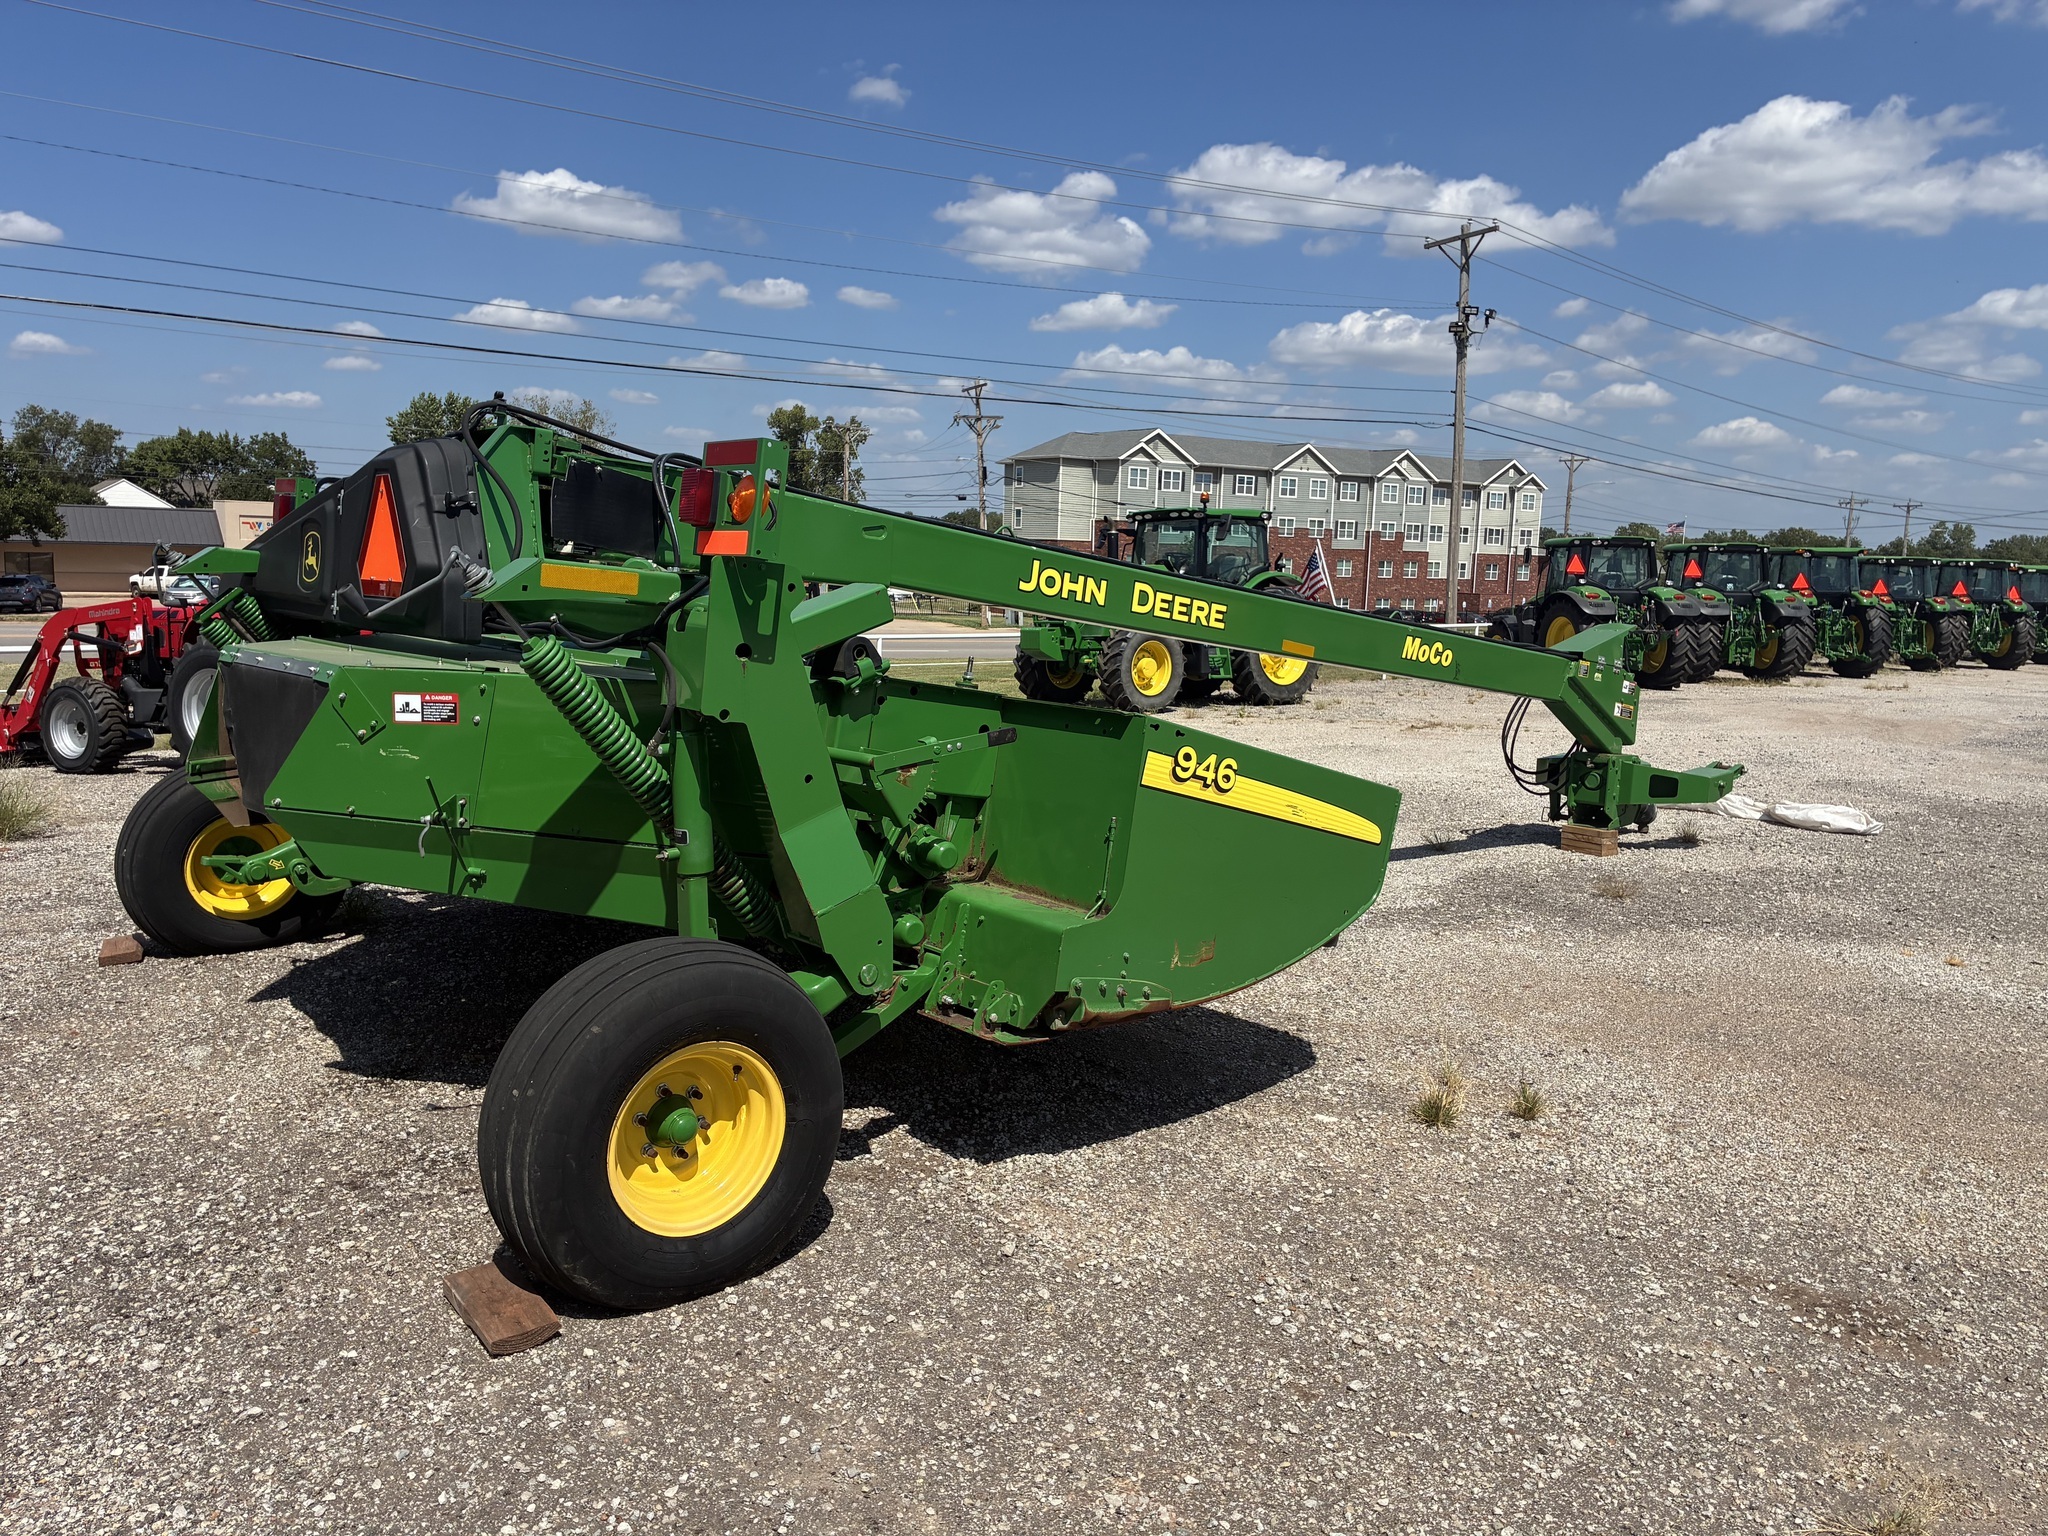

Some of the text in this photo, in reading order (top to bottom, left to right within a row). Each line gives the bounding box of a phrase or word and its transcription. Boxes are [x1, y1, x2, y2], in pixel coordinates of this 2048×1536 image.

[1018, 559, 1228, 630] JOHN DEERE
[1401, 634, 1454, 667] MoCo
[1172, 745, 1238, 794] 946
